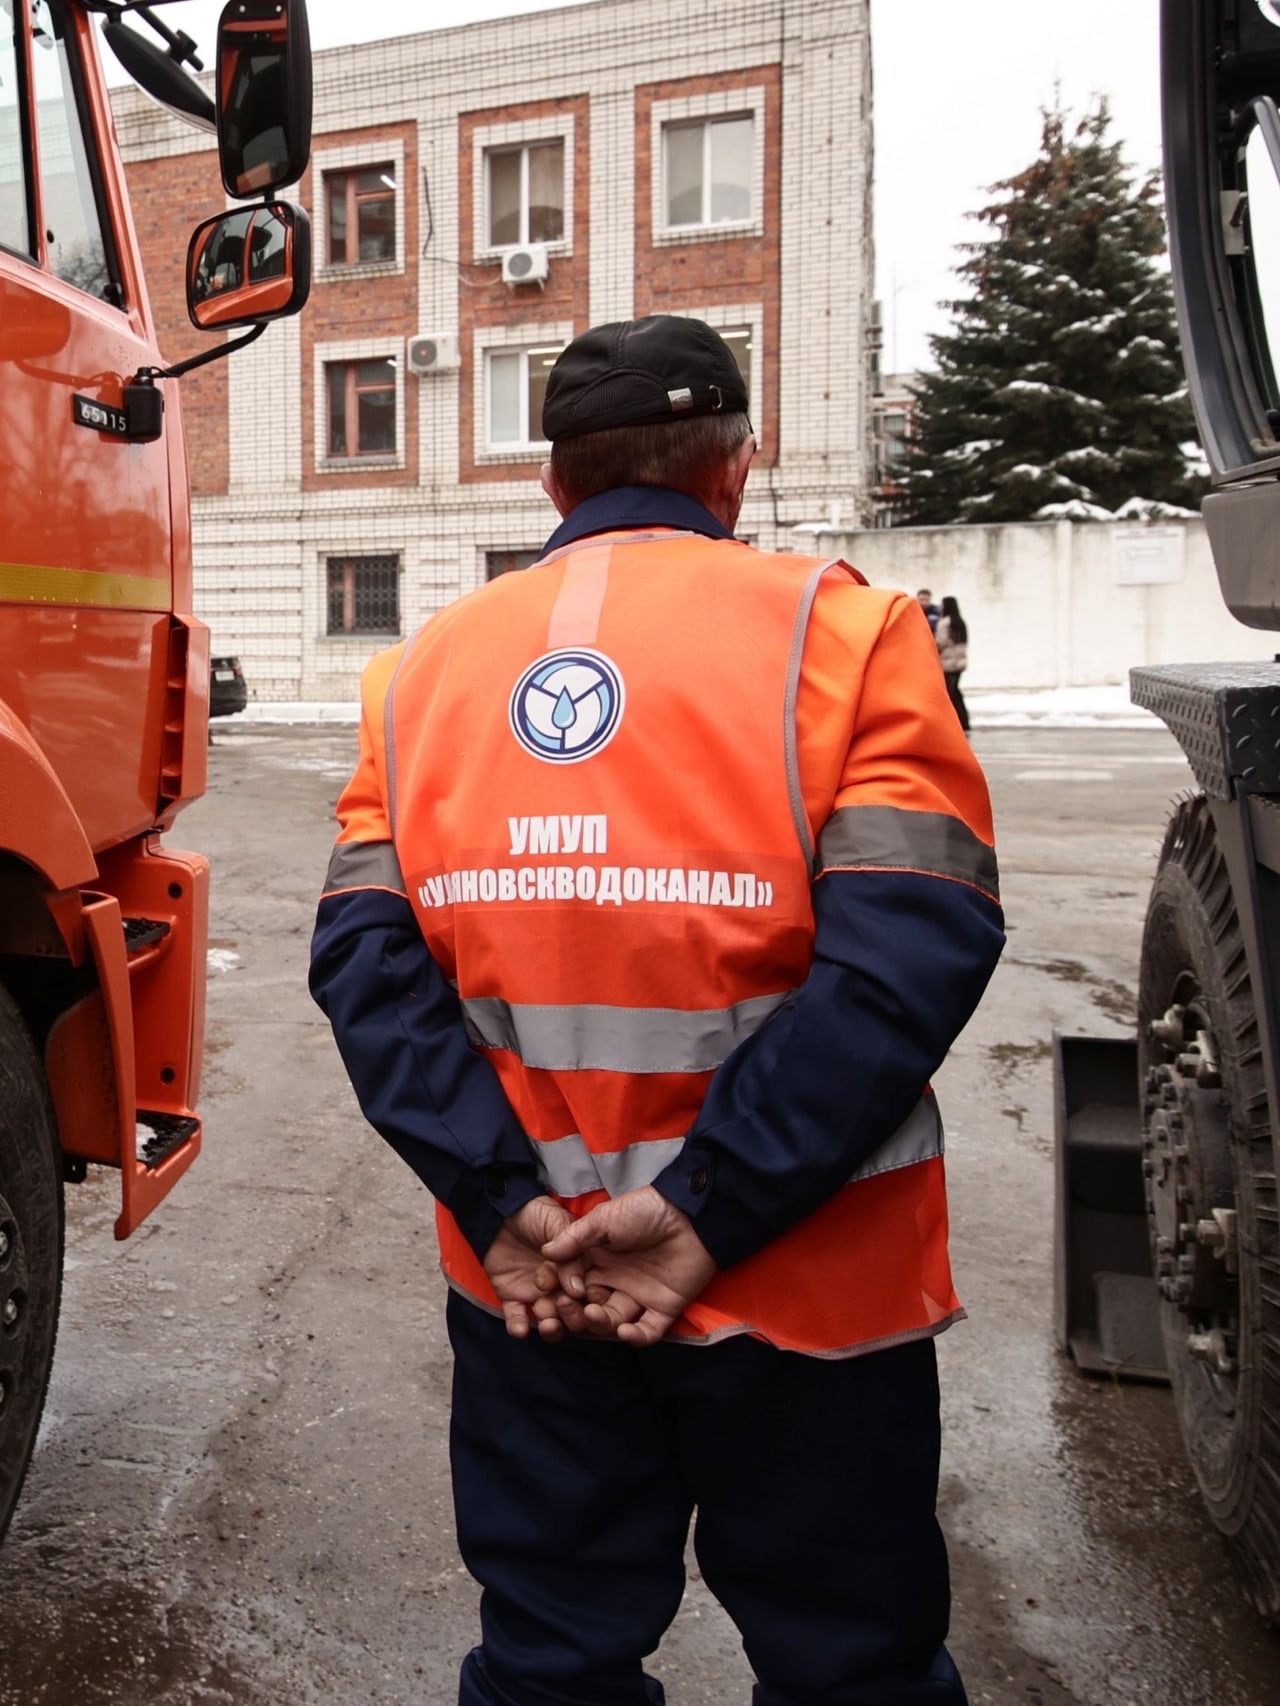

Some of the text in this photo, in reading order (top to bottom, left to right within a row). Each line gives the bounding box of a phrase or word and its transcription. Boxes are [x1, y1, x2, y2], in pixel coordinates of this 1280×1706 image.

[81, 403, 126, 431] 65115
[508, 814, 608, 856] УМУП
[417, 866, 773, 908] «УЯНОВСКВОДОКАНАЛ»
